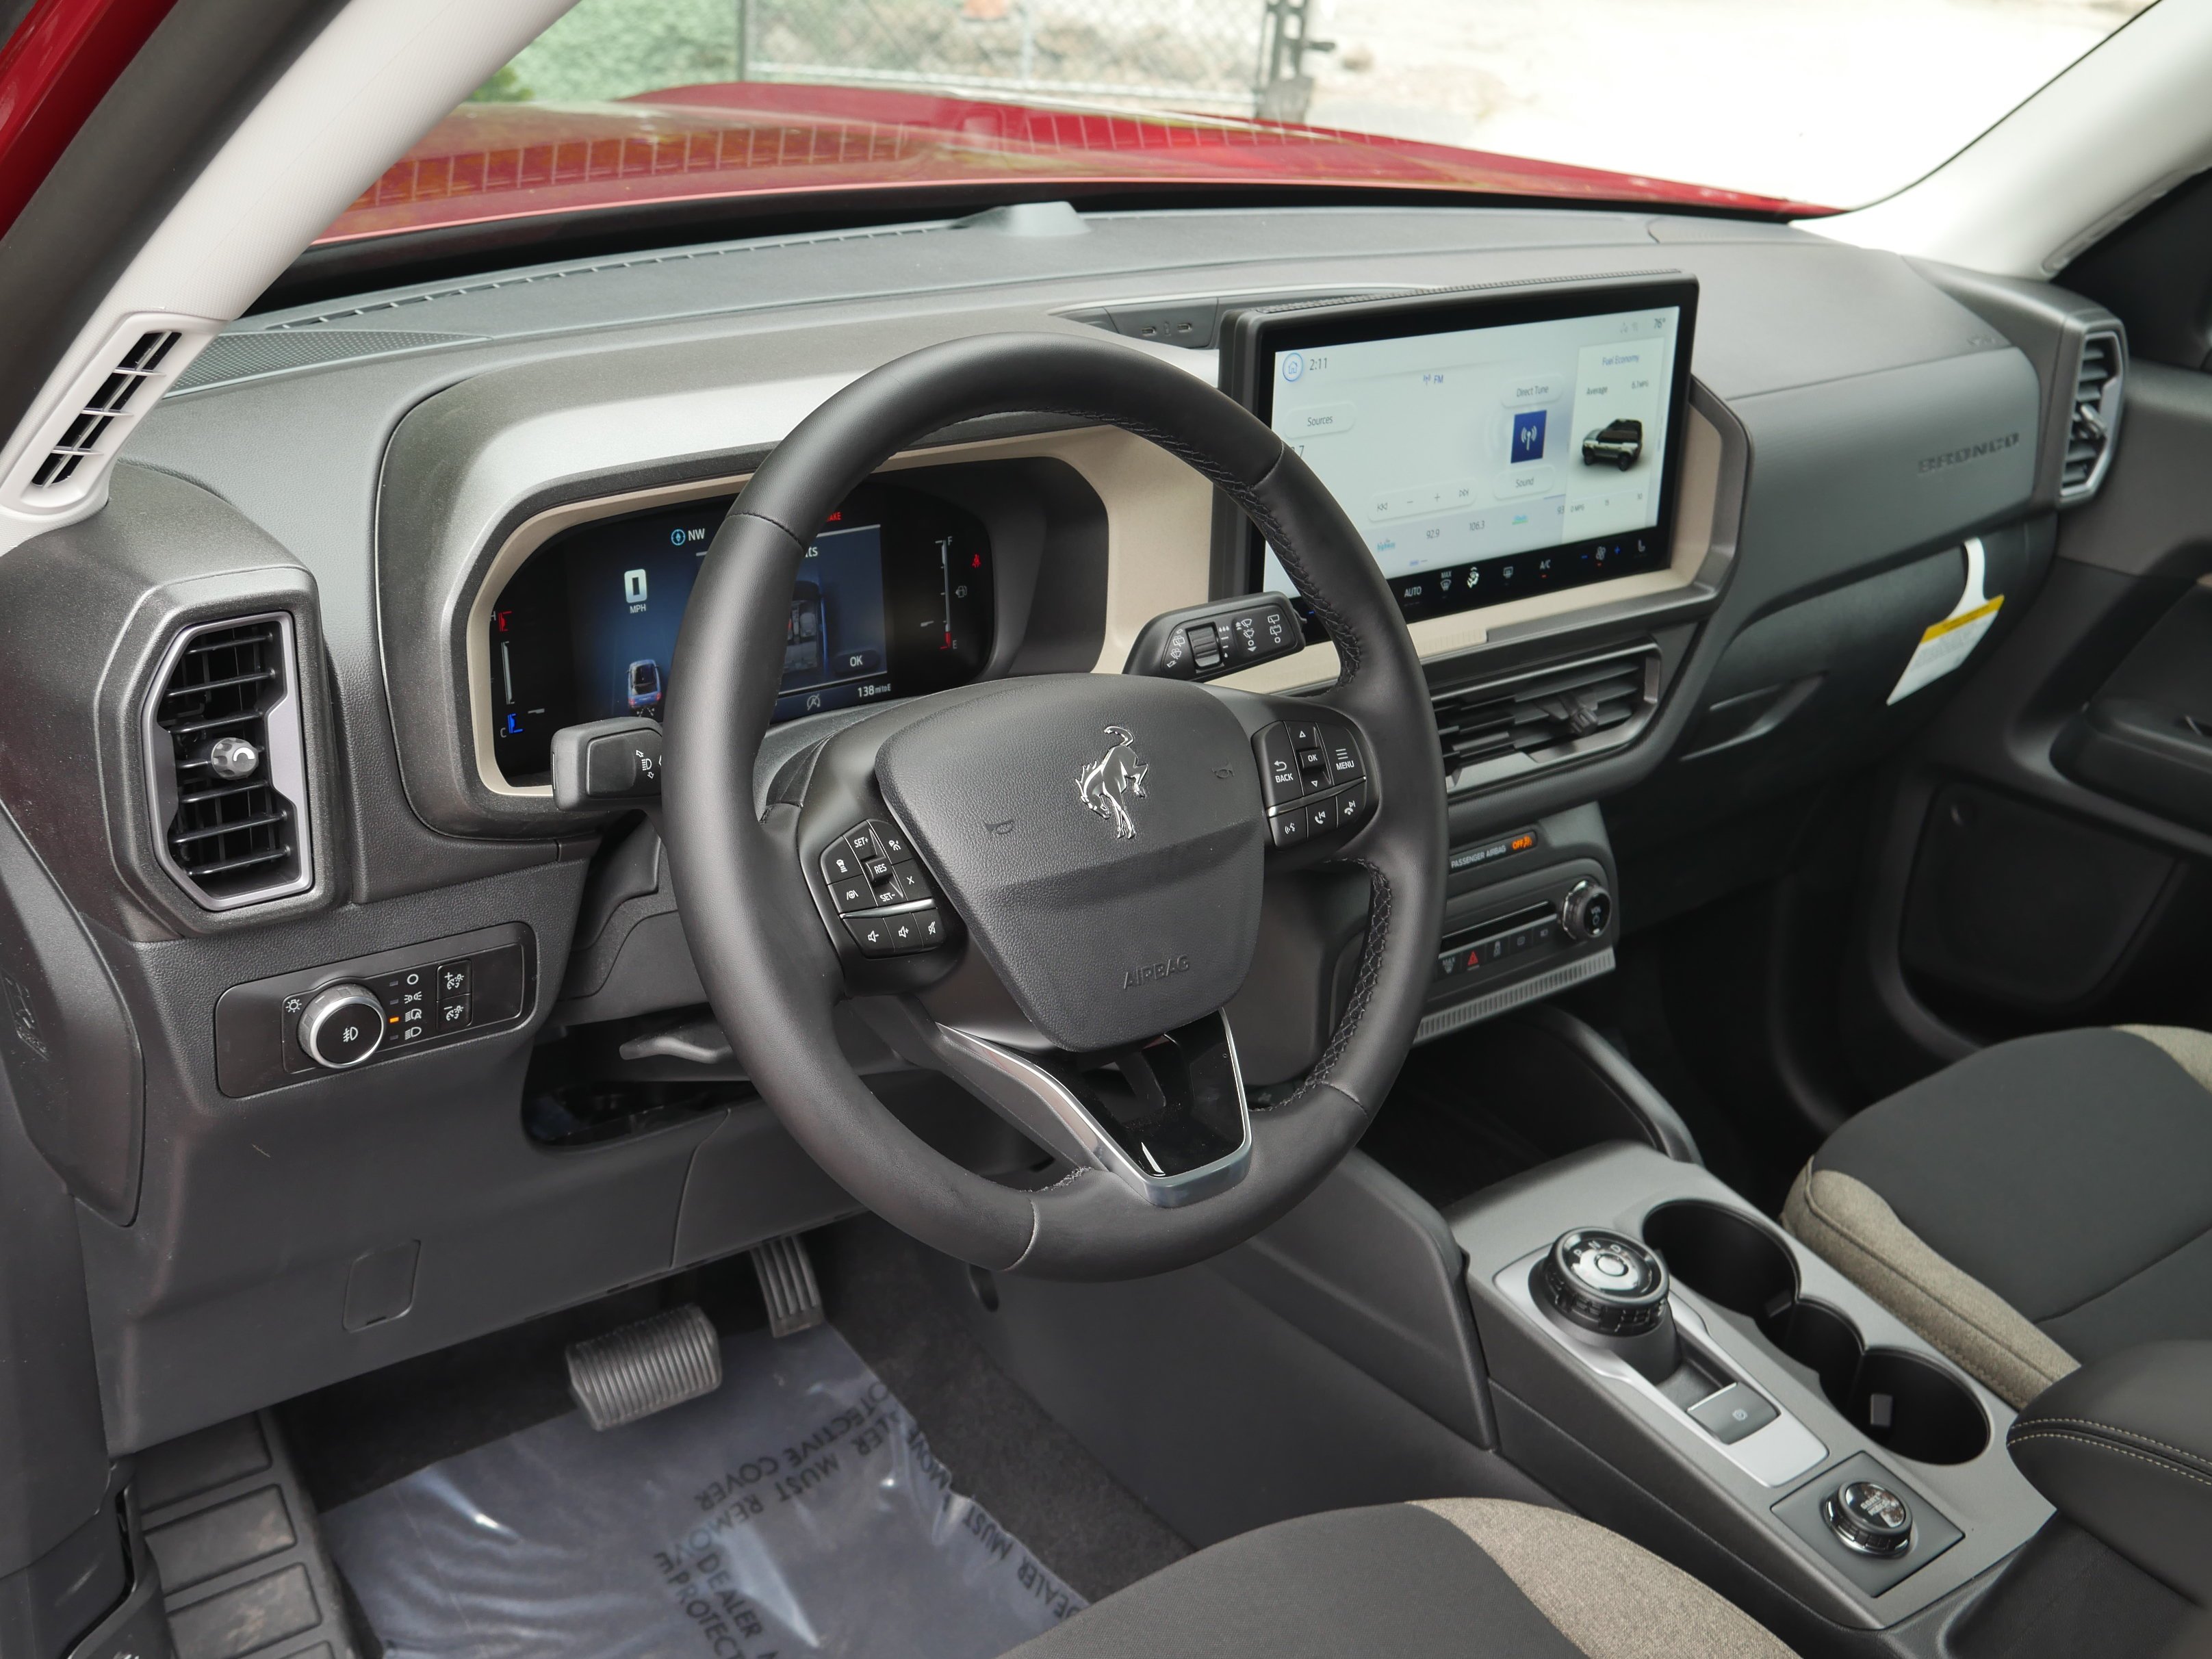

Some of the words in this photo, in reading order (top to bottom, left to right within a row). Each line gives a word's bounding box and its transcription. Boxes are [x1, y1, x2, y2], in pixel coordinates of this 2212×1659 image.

[1309, 357, 1328, 370] 2:11
[1602, 357, 1615, 365] Fuel
[1615, 354, 1639, 364] Economy
[1434, 374, 1443, 384] FM
[1517, 386, 1533, 398] Direct
[1534, 385, 1549, 395] Tune
[1586, 386, 1608, 396] Average
[1307, 415, 1333, 426] Sources
[1917, 432, 2019, 474] BRONCO
[1515, 477, 1534, 488] Sound
[688, 528, 705, 541] NW
[947, 536, 953, 545] F
[1540, 559, 1551, 569] A/C
[1441, 571, 1452, 579] MAX
[624, 569, 647, 603] 0
[1404, 587, 1422, 597] AUTO
[630, 604, 646, 614] MPH
[953, 640, 957, 650] E
[849, 655, 863, 667] OK
[858, 685, 875, 697] 138
[500, 728, 506, 738] C
[1308, 754, 1318, 762] OK
[1335, 760, 1354, 771] MENU
[1275, 773, 1294, 784] BACK
[1451, 853, 1485, 869] PASSENGER
[1486, 845, 1506, 858] AIRBAG
[874, 864, 887, 875] RES
[1123, 954, 1189, 990] AIRBAG
[788, 1382, 889, 1466] OTECTIVE
[851, 1410, 901, 1456] ALER
[694, 1454, 779, 1511] COVER
[776, 1454, 840, 1504] MUST
[654, 1497, 764, 1574] REMOVE
[962, 1505, 1014, 1560] MUST
[697, 1552, 762, 1640] DEALER
